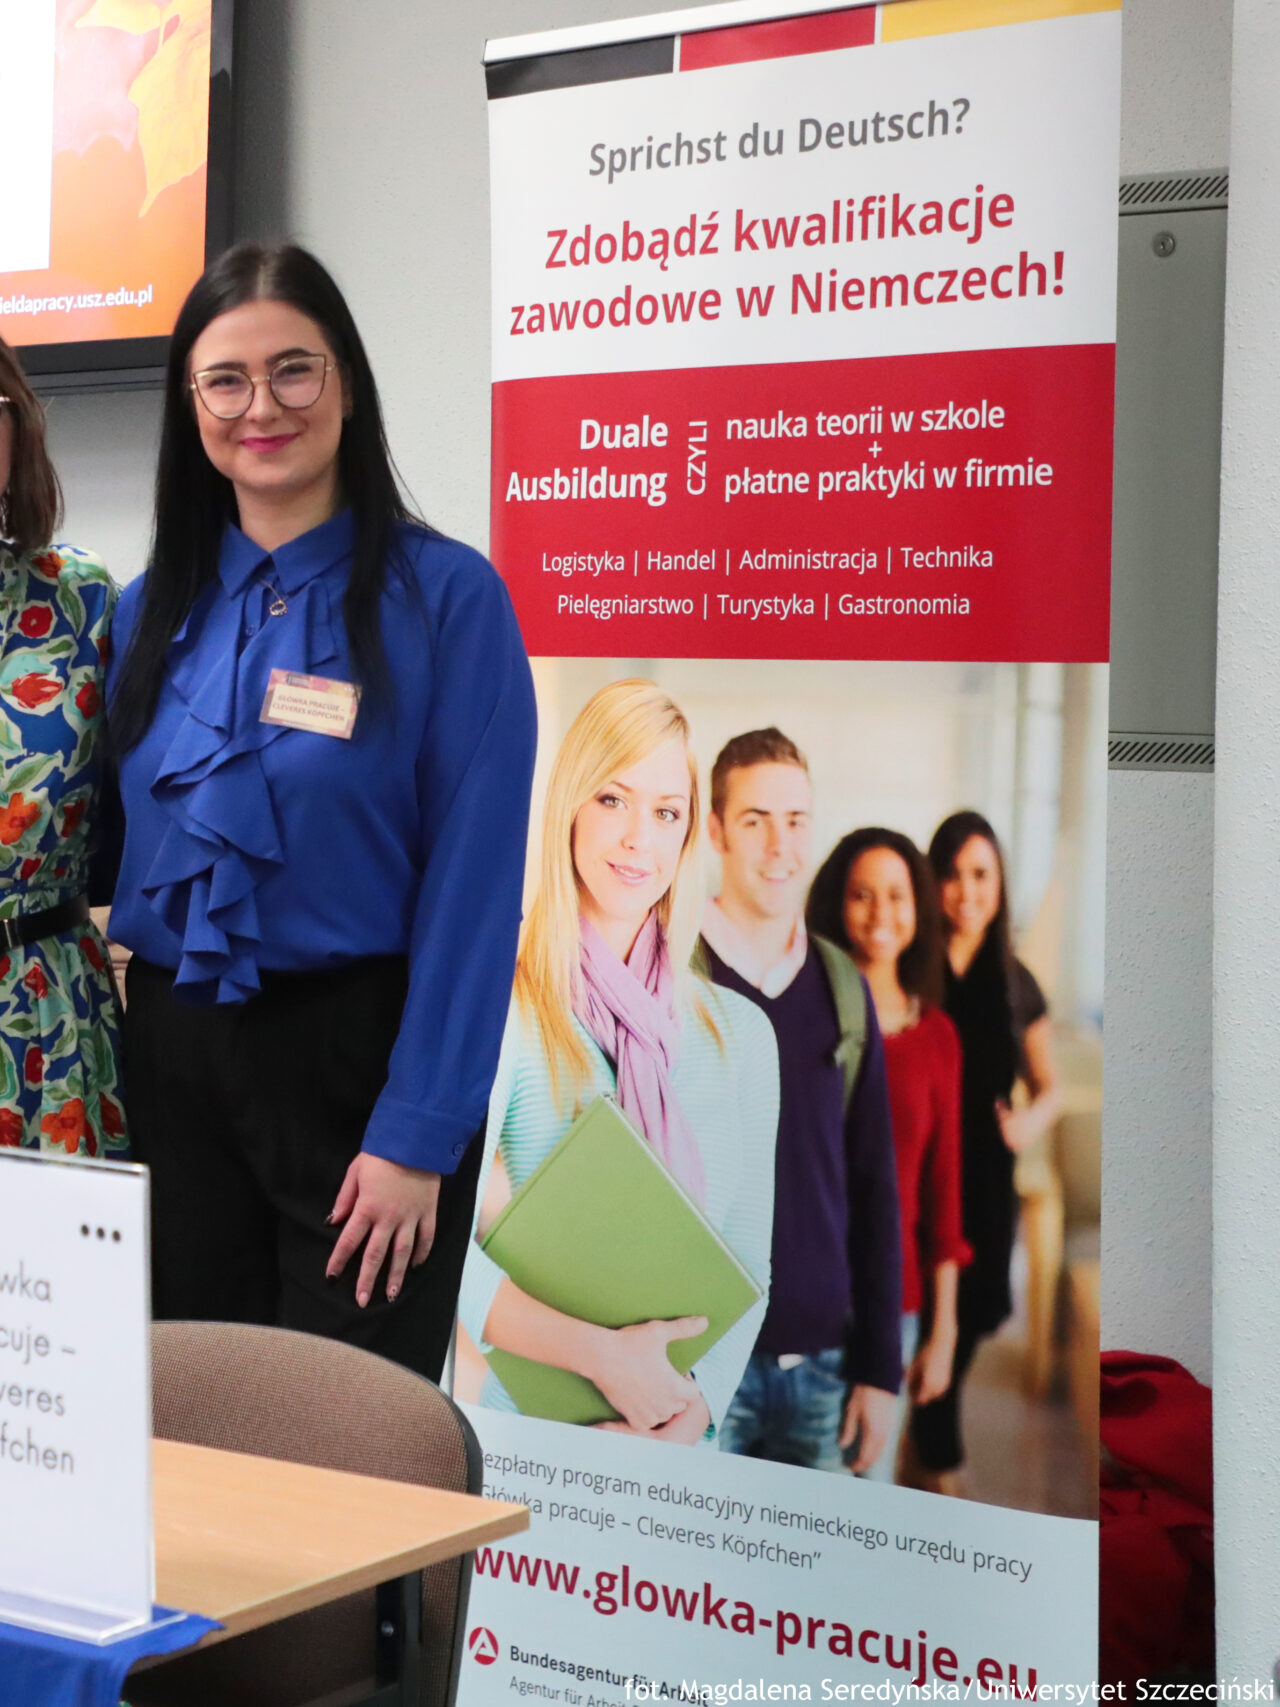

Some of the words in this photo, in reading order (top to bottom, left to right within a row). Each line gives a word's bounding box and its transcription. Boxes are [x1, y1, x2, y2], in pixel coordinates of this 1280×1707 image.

[588, 131, 728, 185] Sprichst
[737, 121, 785, 160] du
[797, 97, 971, 153] Deutsch?
[545, 210, 720, 272] Zdobądź
[733, 183, 1016, 252] kwalifikacje
[509, 284, 722, 336] zawodowe
[736, 285, 776, 318] w
[790, 250, 1066, 316] Niemczech!
[579, 414, 669, 450] Duale
[725, 411, 809, 441] nauka
[816, 405, 884, 438] teorii
[890, 409, 914, 434] w
[920, 399, 1007, 431] szkole
[686, 420, 708, 496] CZYLI
[724, 465, 811, 503] płatne
[817, 460, 927, 501] praktyki
[933, 464, 958, 489] w
[963, 456, 1055, 489] firmie
[505, 465, 668, 507] Ausbildung
[541, 550, 626, 578] Logistyka
[646, 548, 717, 573] Handel
[739, 547, 878, 575] Administracja
[900, 545, 995, 570] Technika
[557, 594, 694, 620] Pielęgniarstwo
[717, 593, 817, 618] Turystyka
[838, 592, 972, 617] Gastronomia
[483, 1448, 557, 1485] ezpłatny
[562, 1466, 641, 1495] program
[647, 1482, 754, 1524] edukacyjny
[760, 1502, 889, 1550] niemieckiego
[895, 1531, 966, 1565] urzędu
[972, 1549, 1033, 1583] pracy
[549, 1500, 616, 1532] pracuje
[637, 1515, 716, 1550] Cleveres
[474, 1546, 1039, 1702] www.glowka-pracuje.eu
[509, 1645, 629, 1688] Bundesagentur
[509, 1674, 560, 1701] Agentur
[564, 1686, 583, 1706] für
